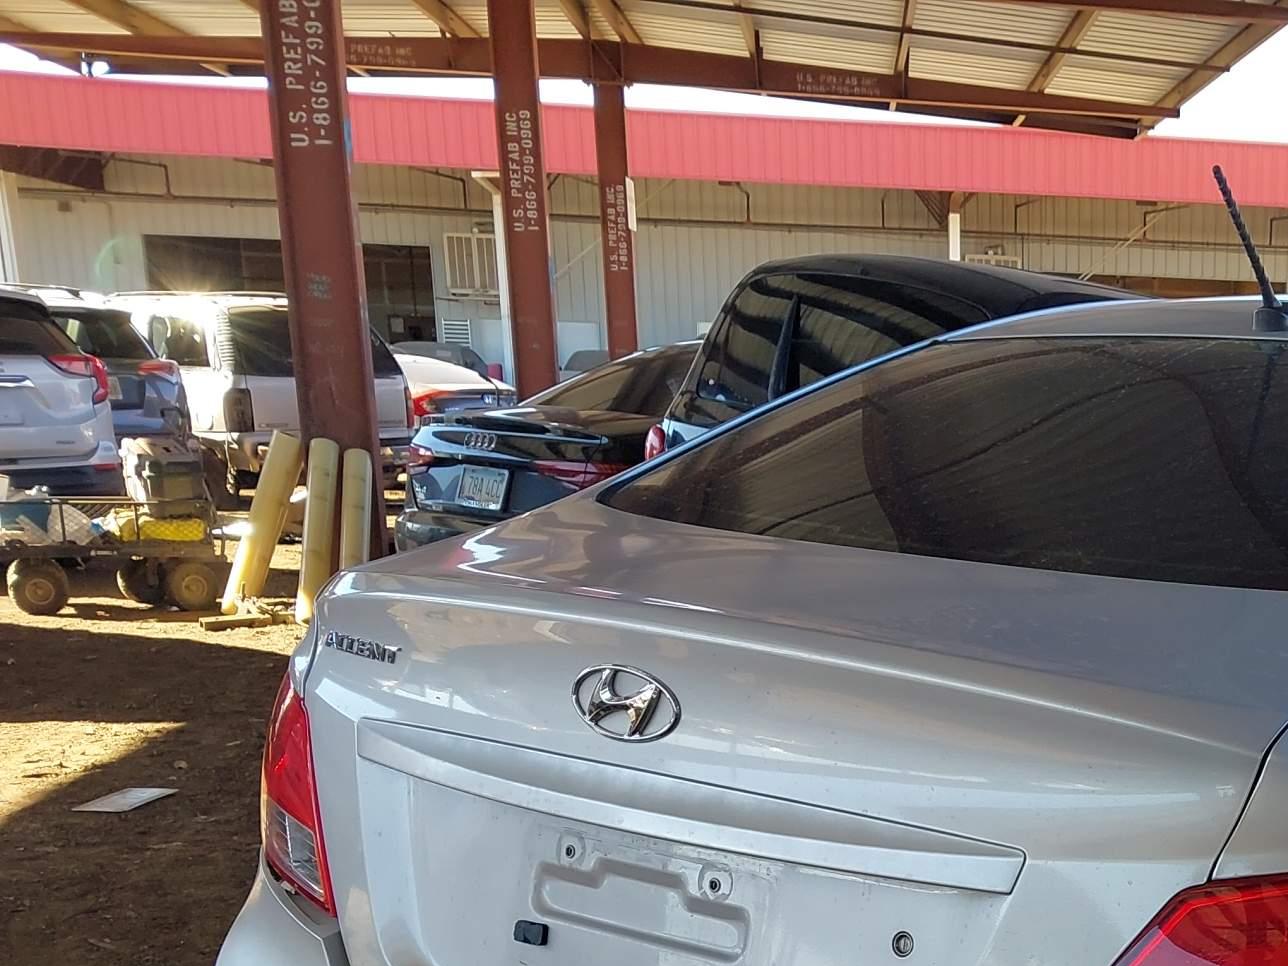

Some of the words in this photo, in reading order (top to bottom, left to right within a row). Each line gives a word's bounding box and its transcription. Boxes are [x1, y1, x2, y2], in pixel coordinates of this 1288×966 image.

[279, 0, 305, 90] PREFAB
[288, 103, 310, 147] U.S.
[507, 142, 523, 198] PREFAB
[519, 109, 540, 231] 1-866-799-0969
[607, 207, 618, 247] PREFAB
